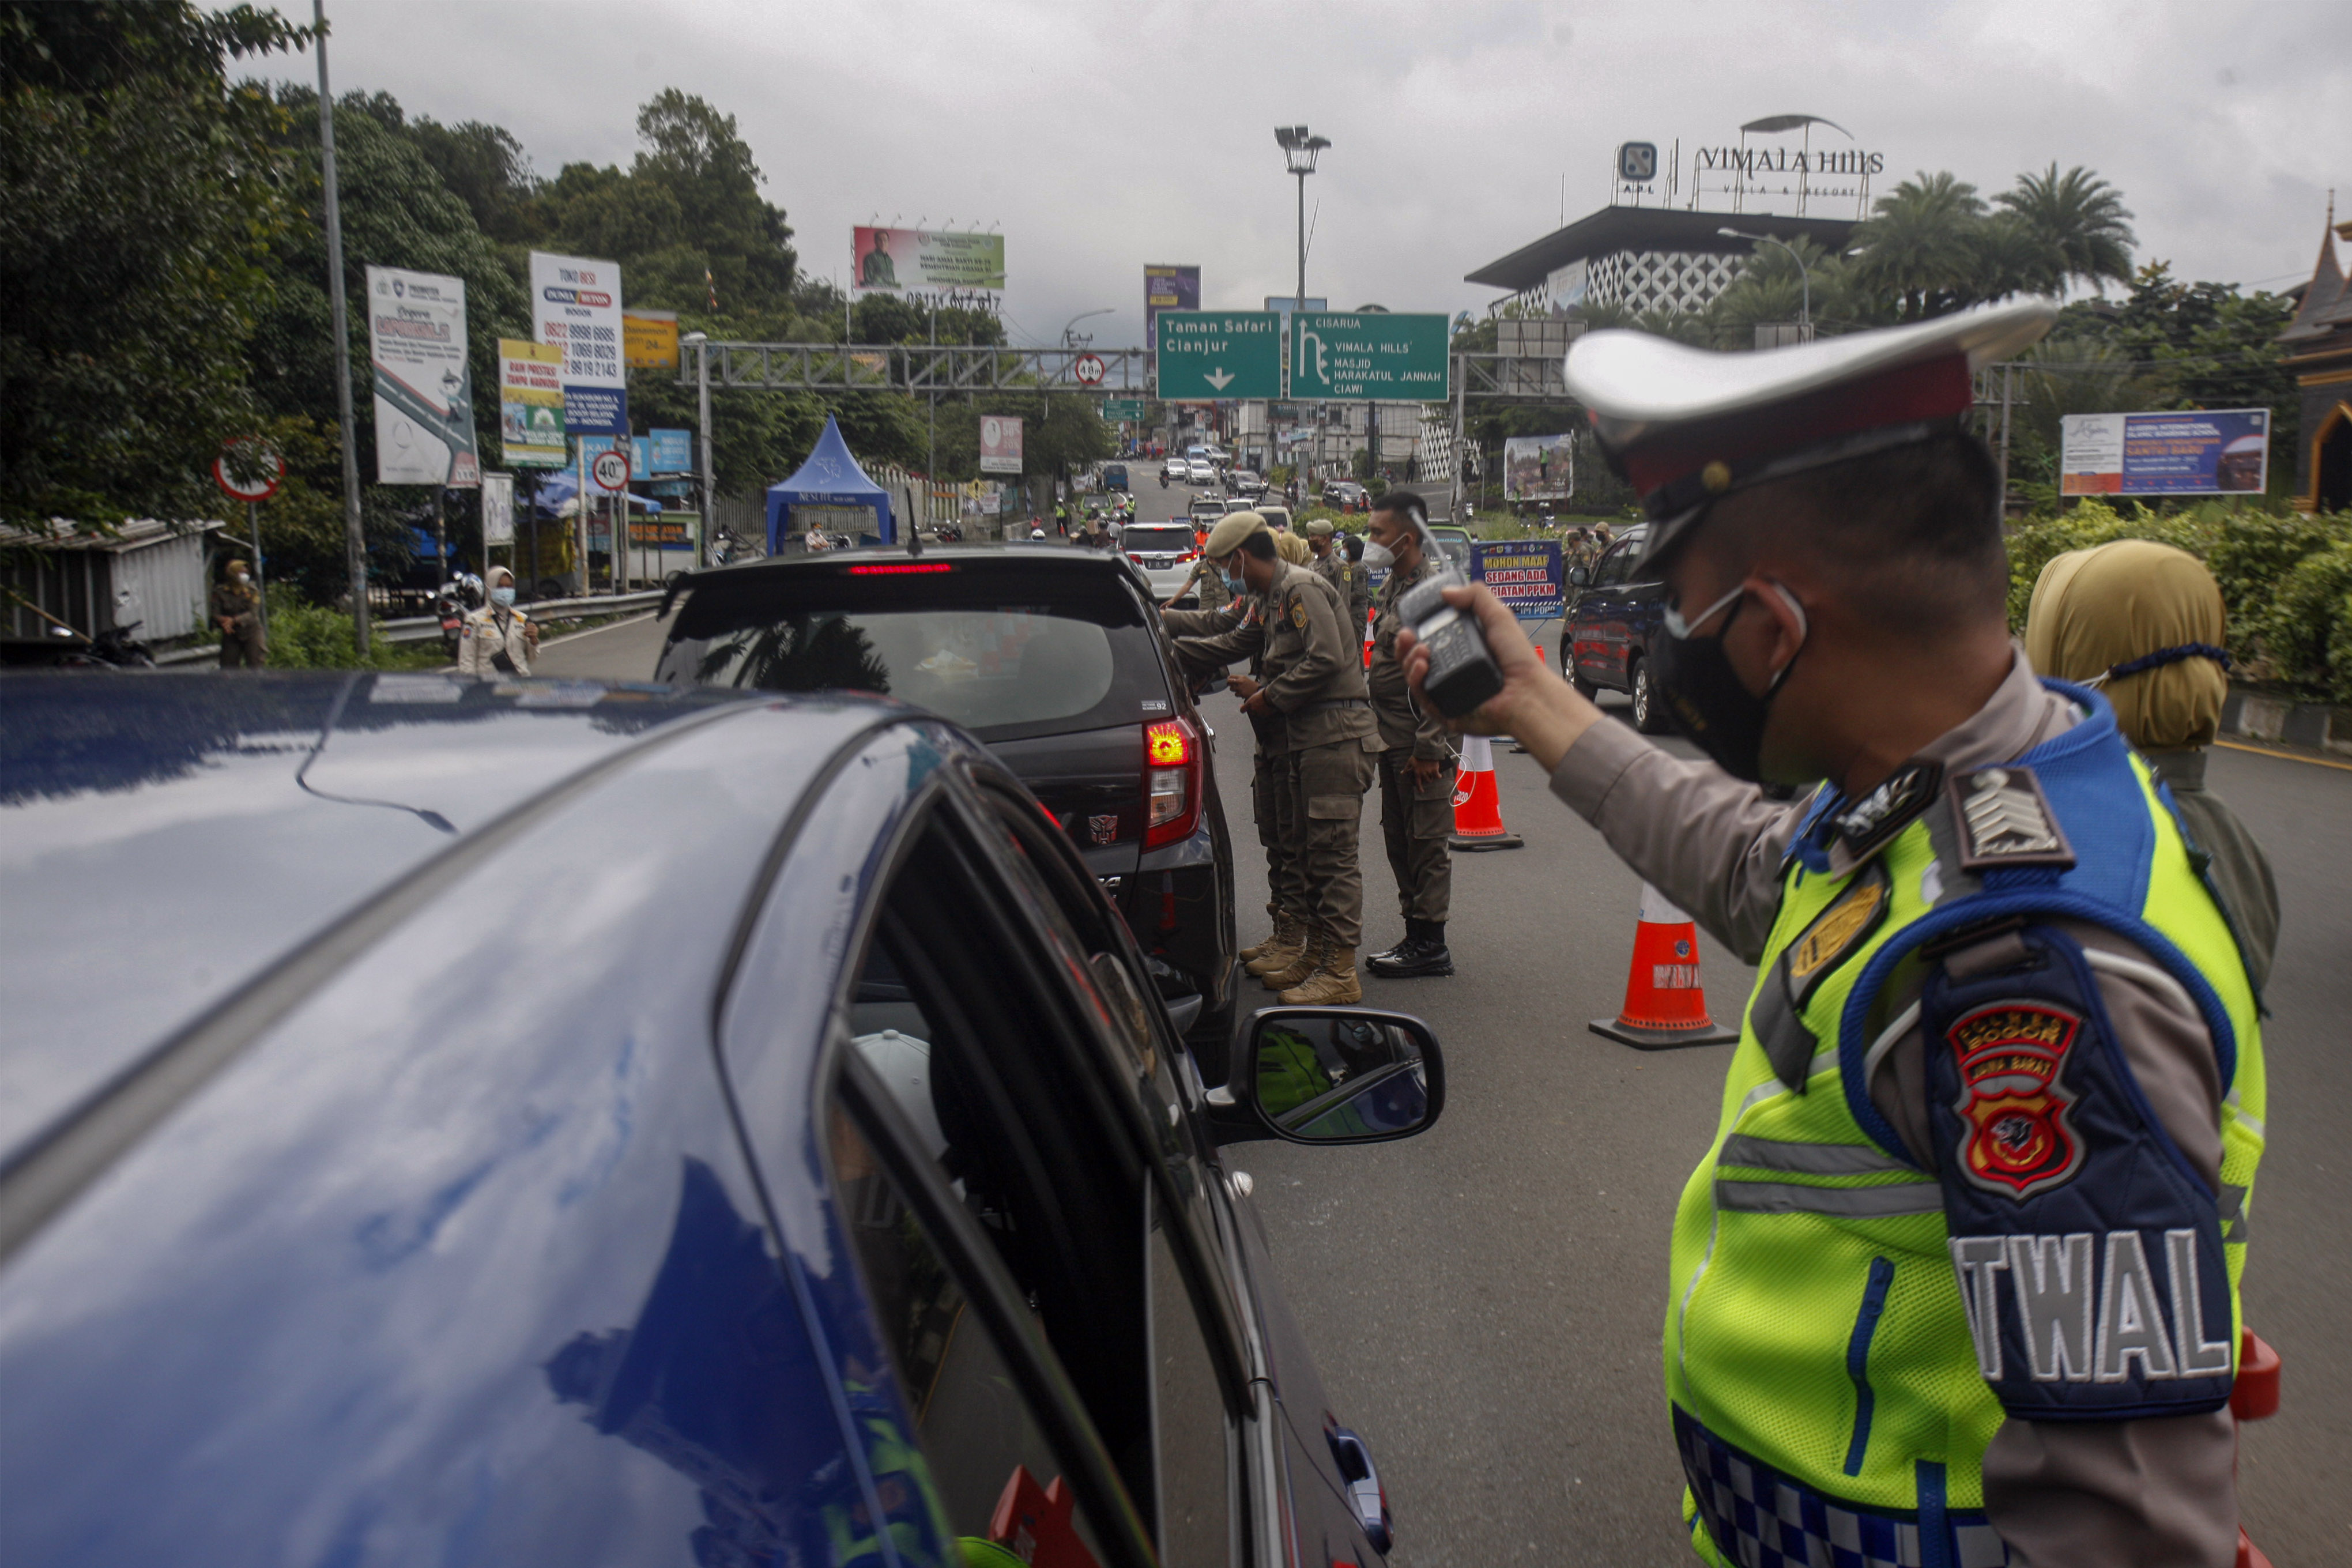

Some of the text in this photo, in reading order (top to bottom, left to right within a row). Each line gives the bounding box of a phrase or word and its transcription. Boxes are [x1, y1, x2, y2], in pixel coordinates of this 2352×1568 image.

[1701, 146, 1809, 180] VIMALA
[548, 289, 608, 305] DUNIA BETON
[1166, 319, 1272, 333] Taman Safari
[1316, 318, 1360, 329] CISARUA
[1166, 338, 1228, 355] Cianjur
[1336, 342, 1408, 353] VIMALA HILLS
[1335, 359, 1370, 368] MASJID
[1335, 371, 1441, 382] HARAKATUL JANNAH
[1335, 385, 1362, 394] CIAWI
[599, 461, 616, 478] 40
[1484, 555, 1549, 570] MOHON MAAF
[1486, 569, 1547, 583] SEDANG ADA
[1487, 583, 1556, 598] GIATAN PPKM
[1967, 1026, 2061, 1051] BOGOR
[1972, 1056, 2053, 1080] JAWA BARAT
[1948, 1228, 2231, 1382] TWAL
